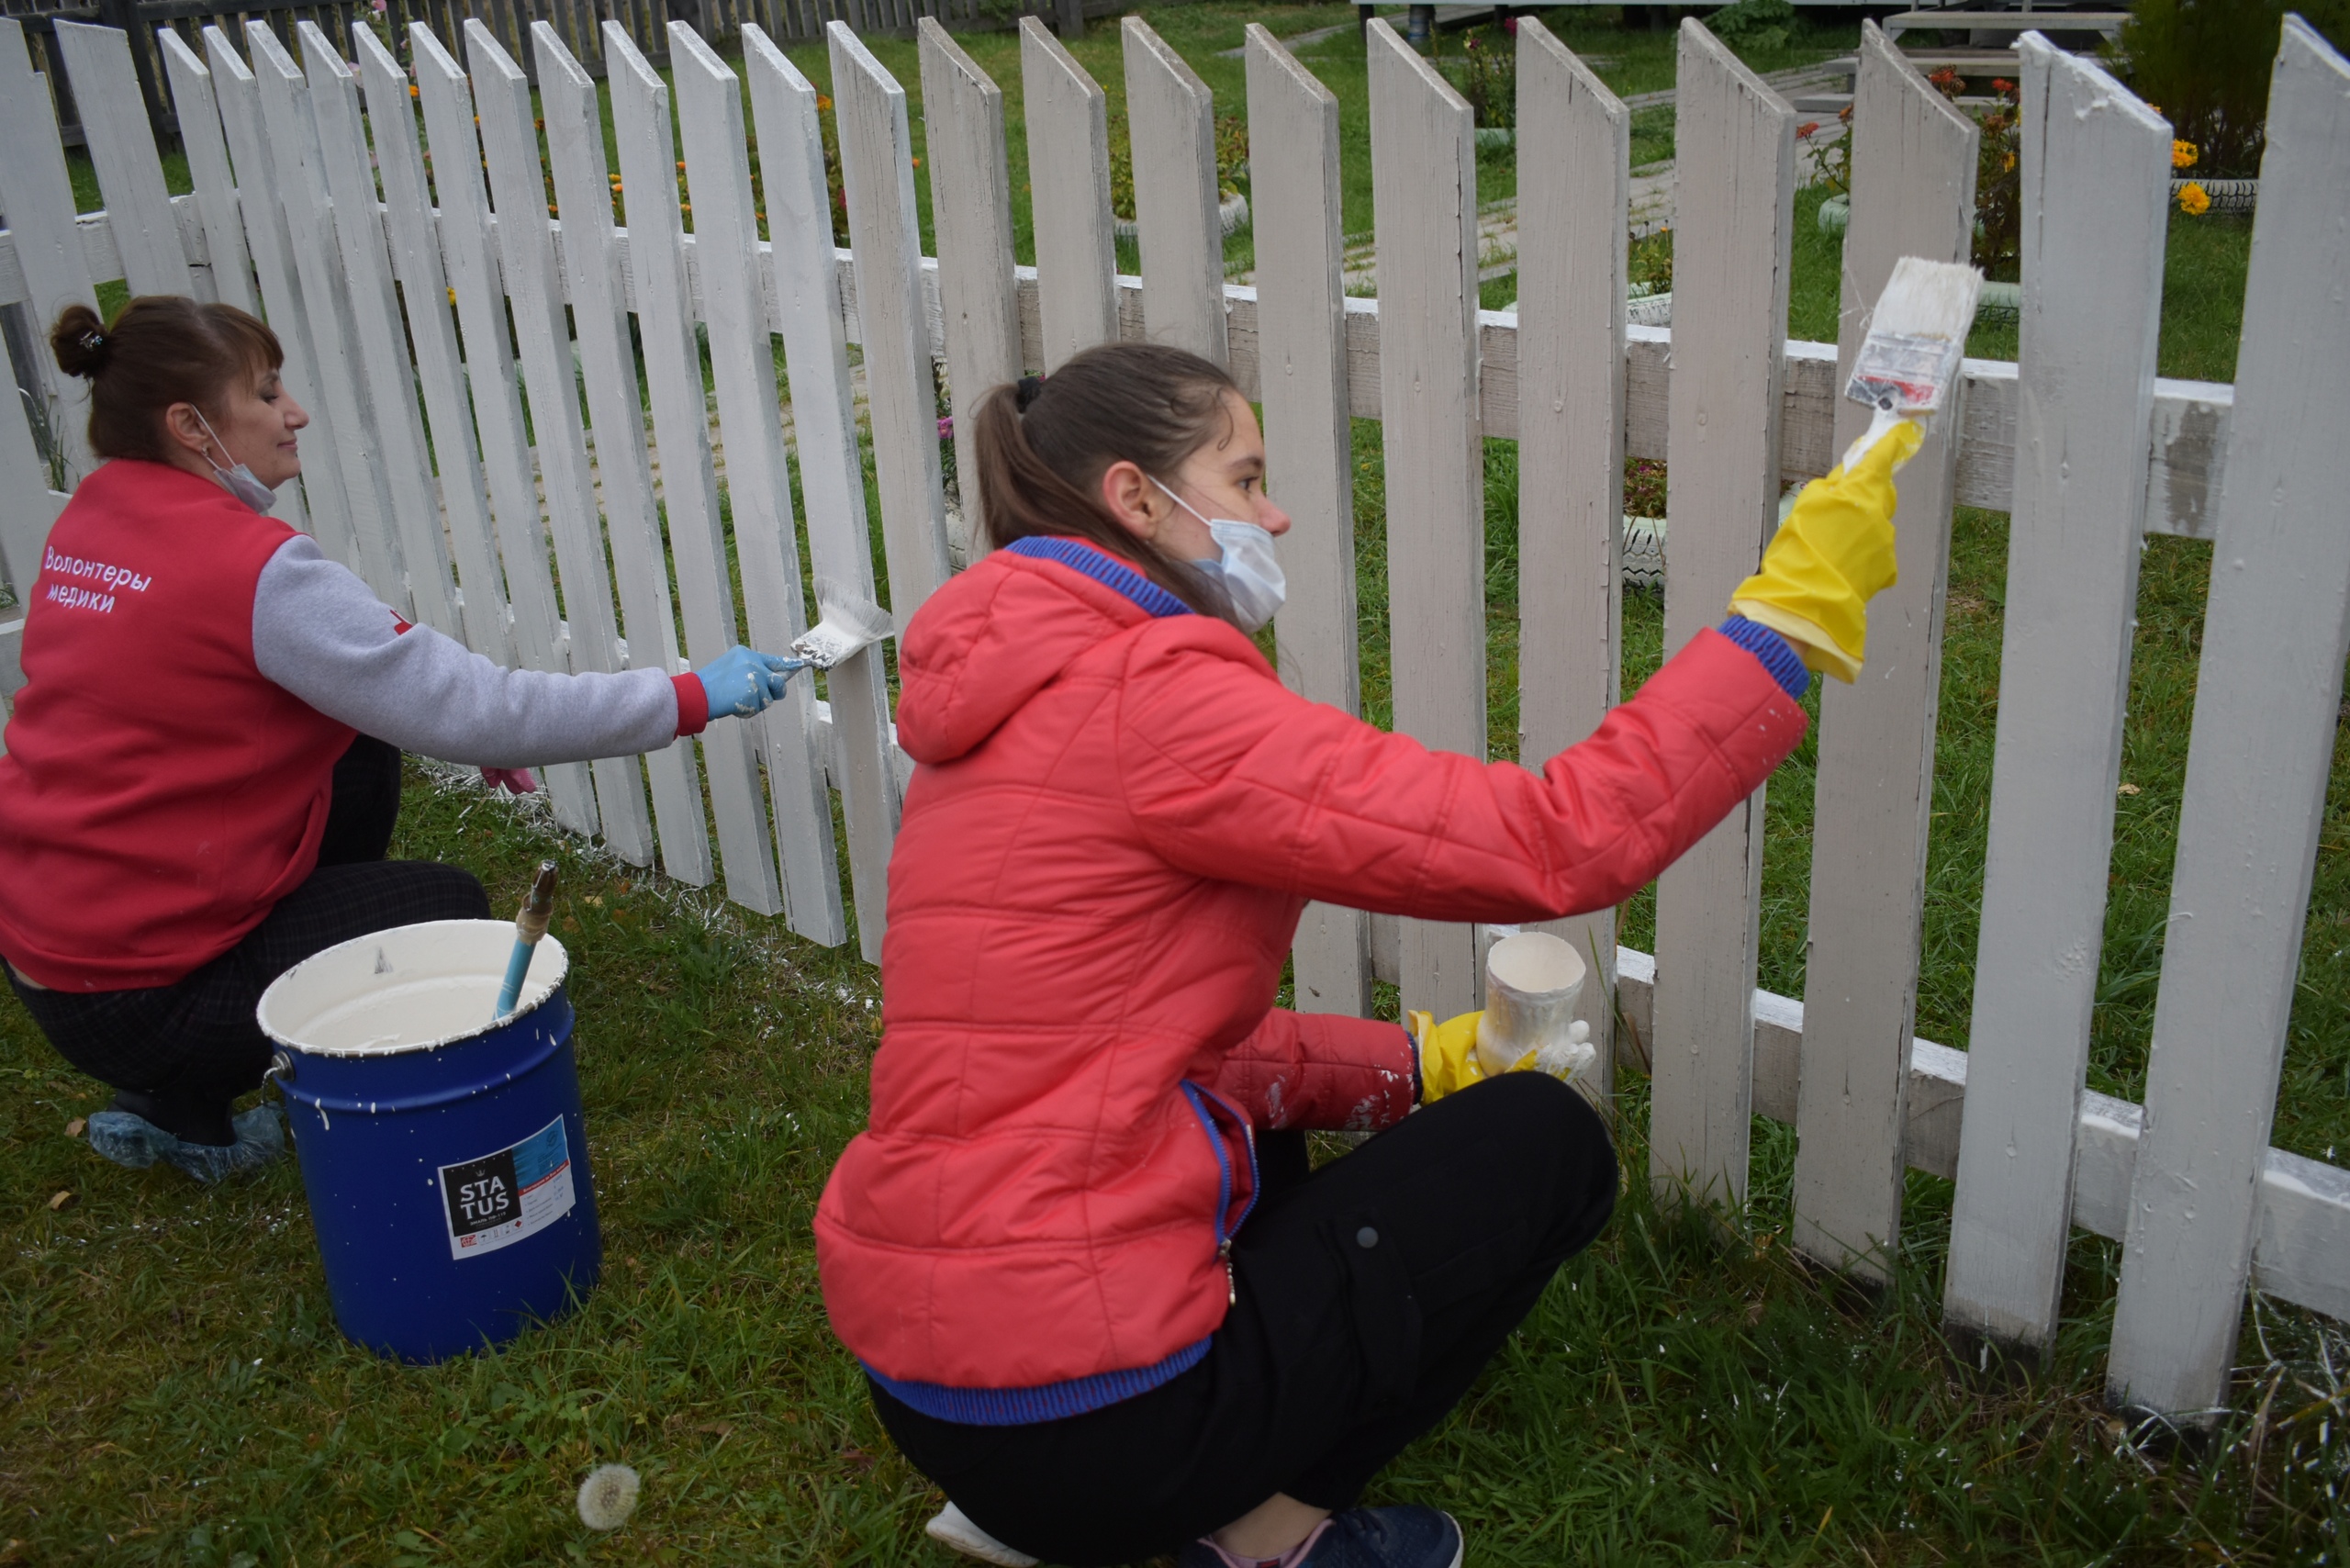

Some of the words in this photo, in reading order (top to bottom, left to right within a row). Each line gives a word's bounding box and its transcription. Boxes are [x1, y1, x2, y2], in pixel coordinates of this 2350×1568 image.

[45, 545, 152, 591] Волонтеры
[47, 583, 116, 613] медики
[460, 1176, 506, 1203] STA
[460, 1192, 509, 1220] TUS
